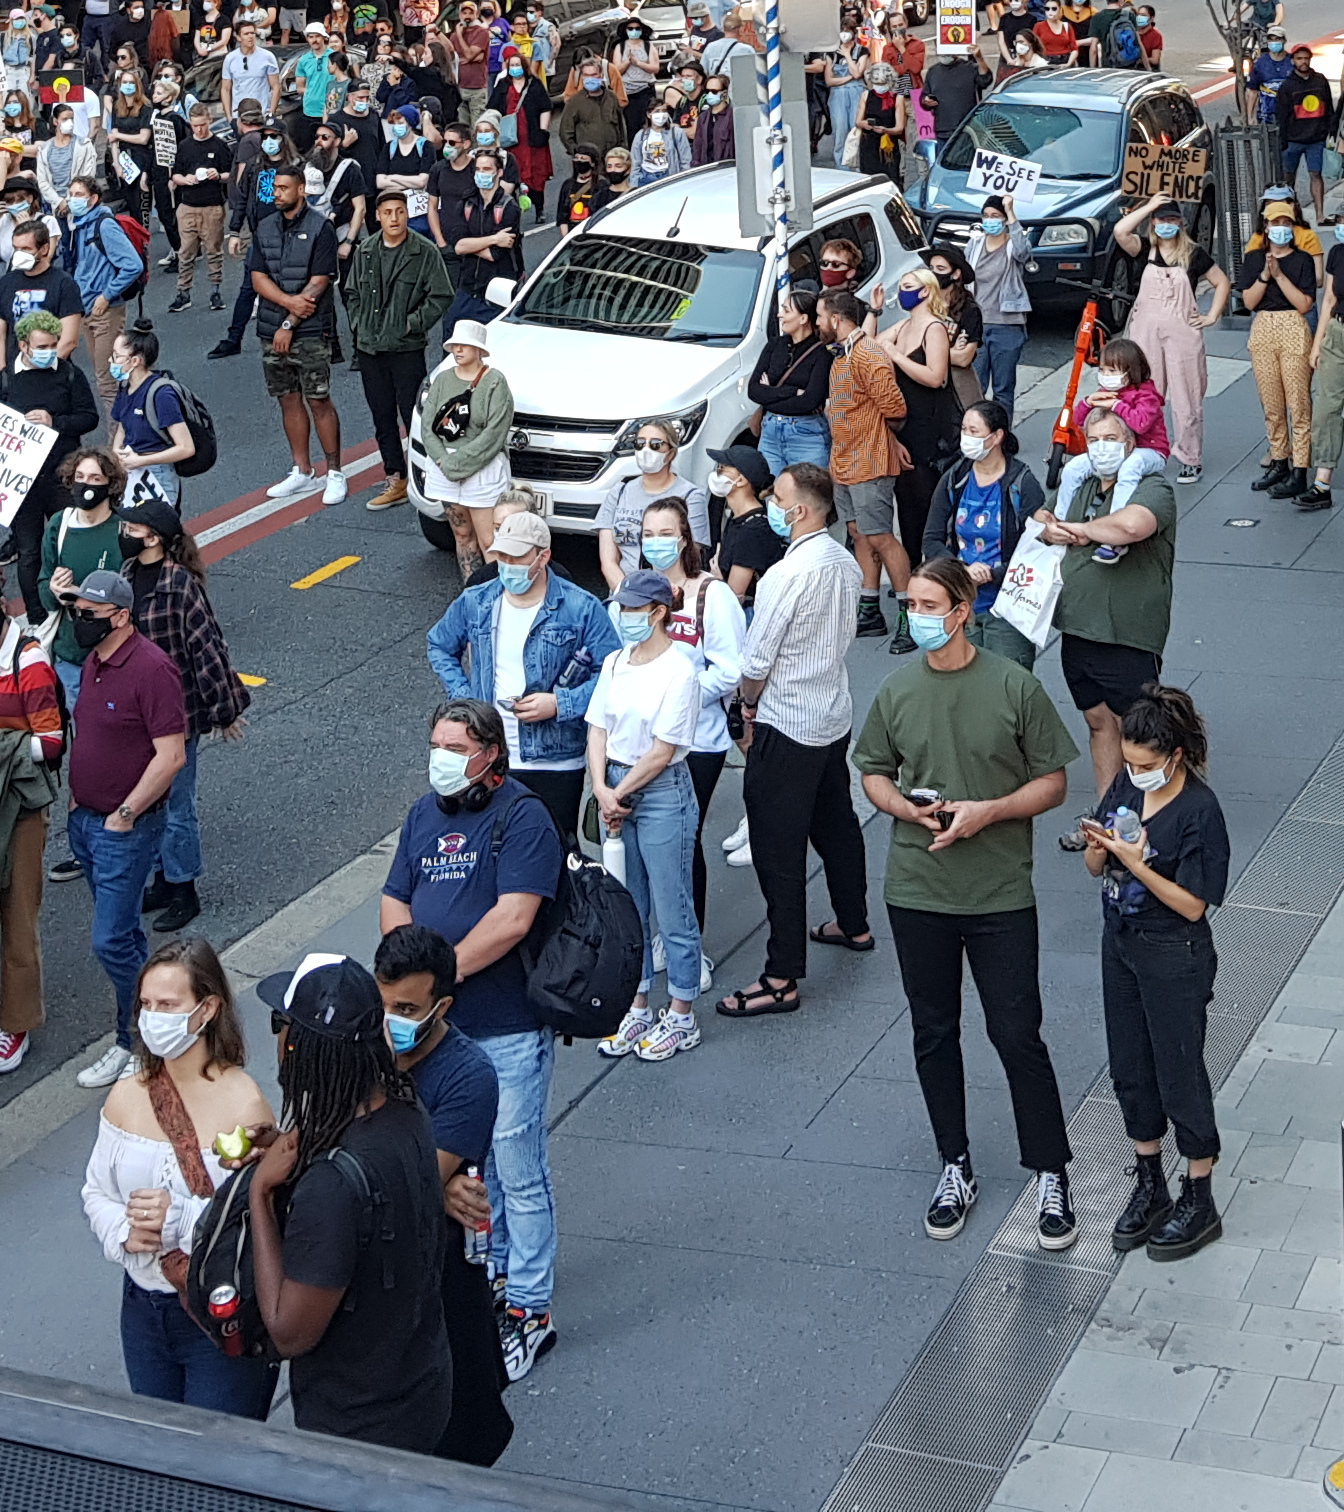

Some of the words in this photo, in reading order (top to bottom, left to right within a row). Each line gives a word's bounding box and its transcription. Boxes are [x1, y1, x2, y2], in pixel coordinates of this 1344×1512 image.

[1128, 145, 1149, 159] NO
[1159, 148, 1202, 163] MORE
[1141, 160, 1187, 174] WHITE
[981, 172, 1020, 193] YOU
[1124, 171, 1203, 200] SILENCE
[19, 423, 45, 445] WILL
[421, 856, 447, 867] PALM
[430, 871, 466, 883] FLORIDA
